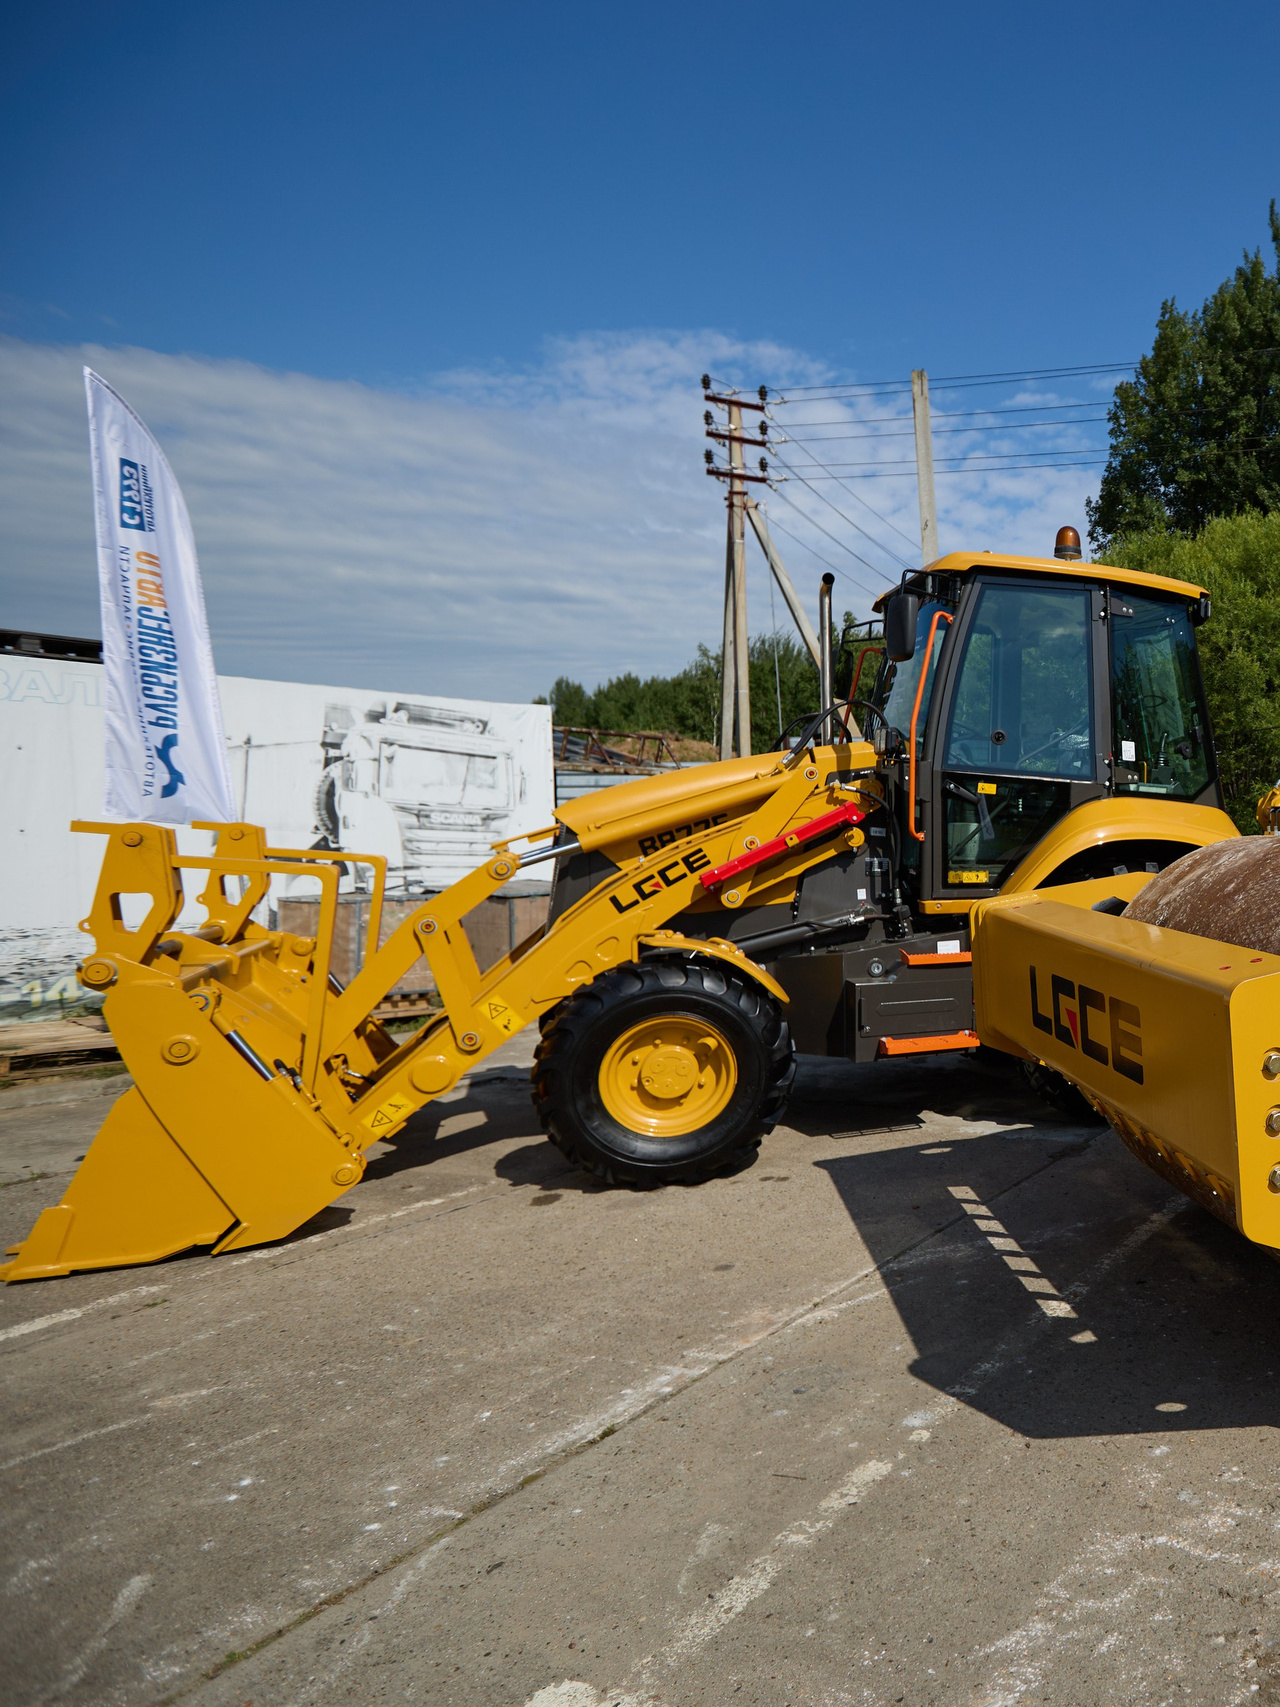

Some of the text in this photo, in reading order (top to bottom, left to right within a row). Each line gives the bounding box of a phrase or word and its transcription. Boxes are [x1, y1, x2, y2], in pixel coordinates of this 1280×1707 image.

[429, 811, 483, 826] SCANIA
[609, 847, 712, 914] LGCE
[1029, 965, 1146, 1086] LGCE
